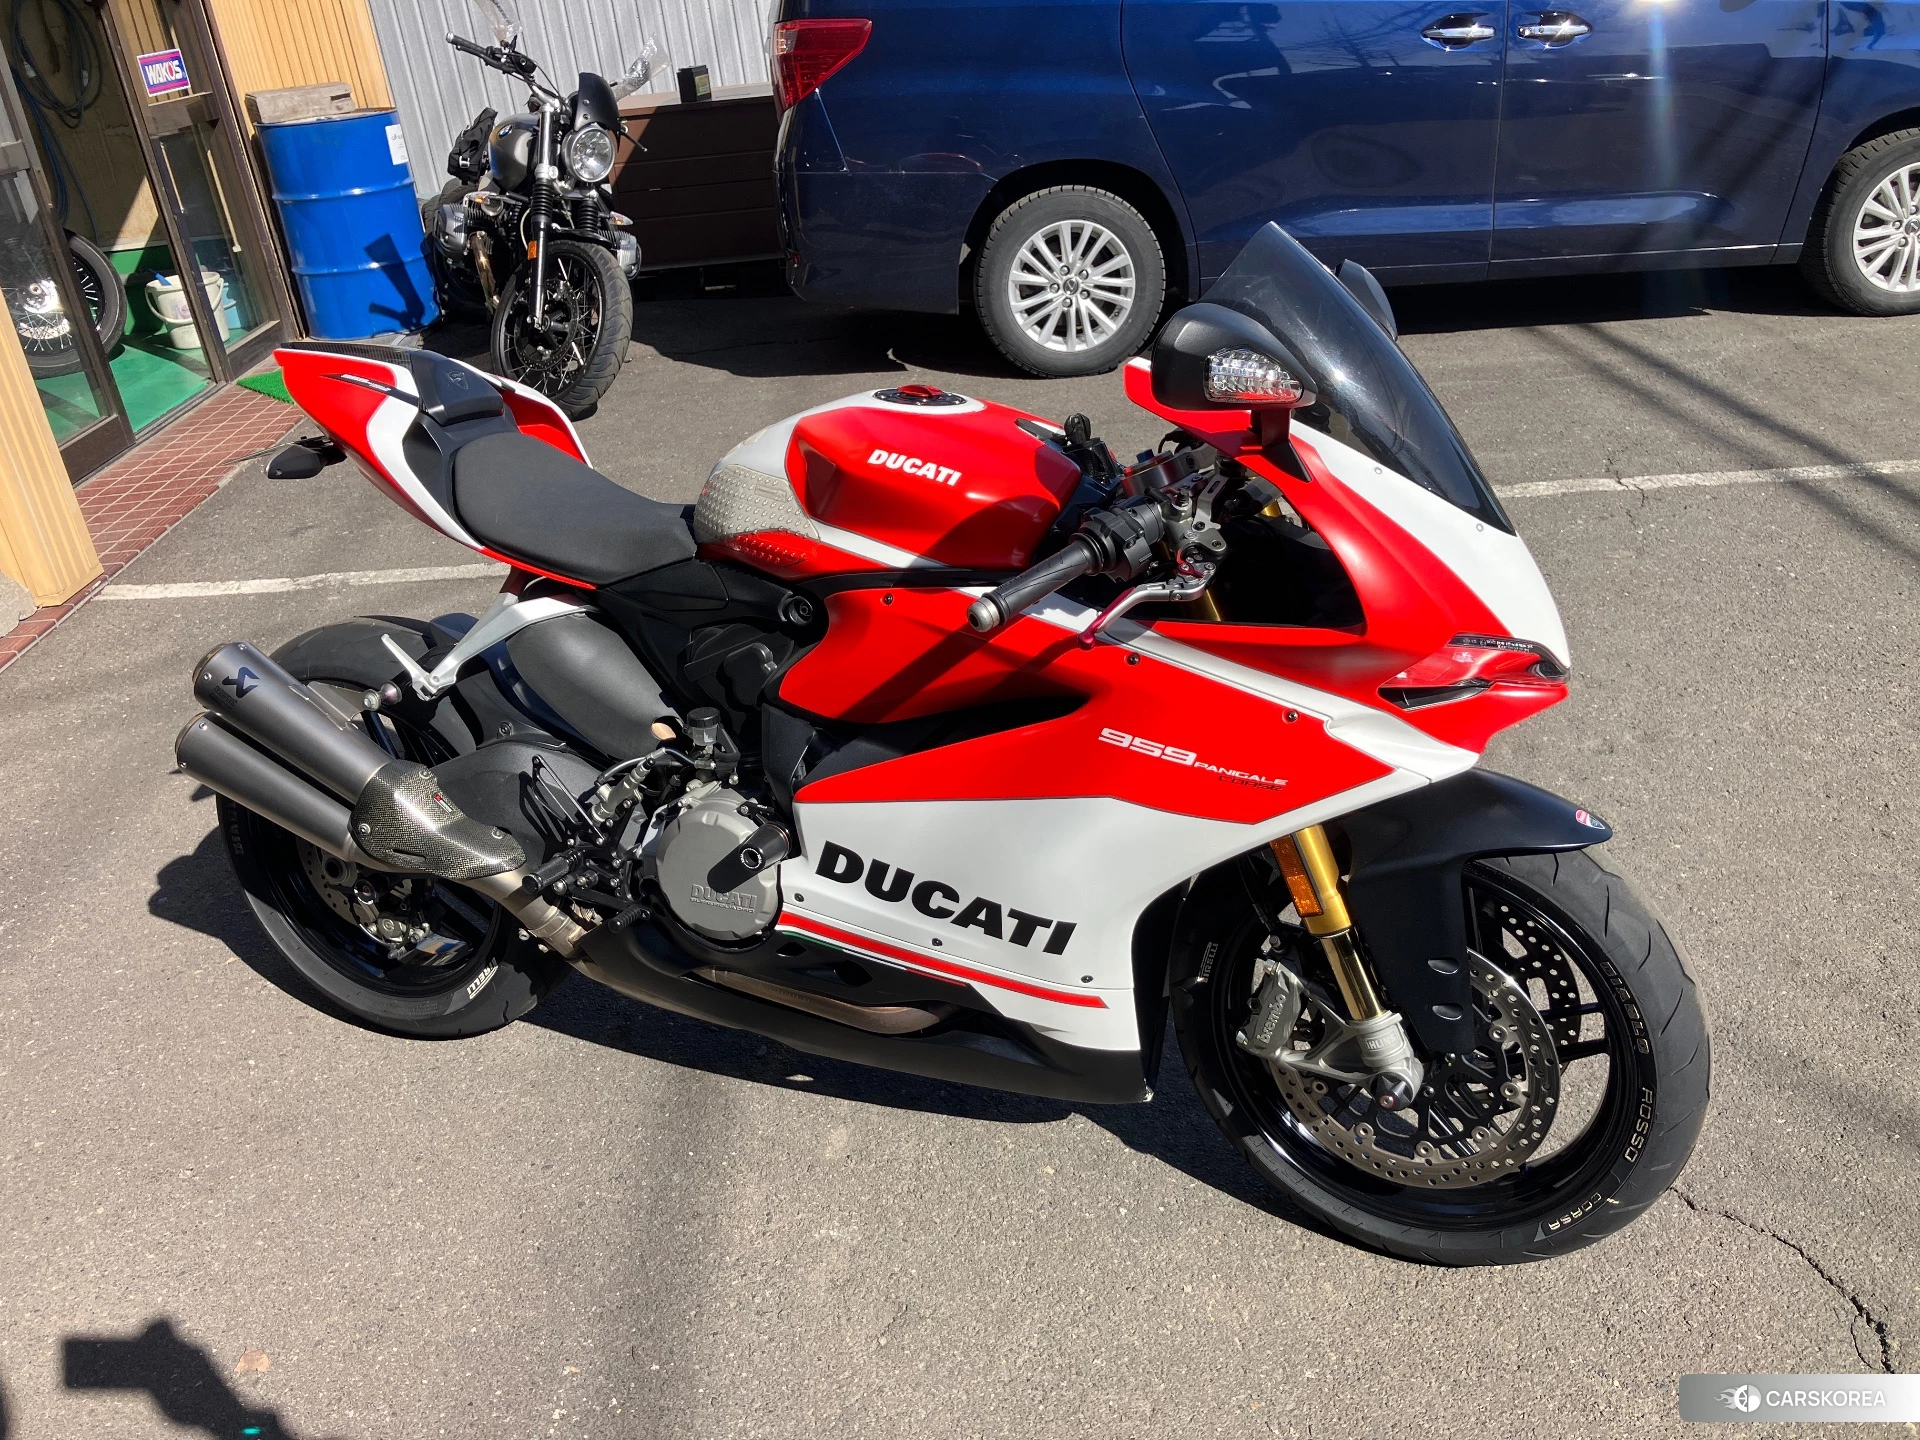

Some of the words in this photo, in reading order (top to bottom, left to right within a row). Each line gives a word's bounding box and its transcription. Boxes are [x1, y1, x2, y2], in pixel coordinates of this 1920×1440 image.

[867, 448, 962, 487] DUCATI
[1098, 727, 1197, 767] 959
[1193, 761, 1289, 787] PANIGALE
[816, 841, 1077, 956] DUCATI
[1256, 993, 1287, 1045] brembo
[1624, 1086, 1653, 1163] ROSSO
[1548, 1192, 1602, 1231] CORSA
